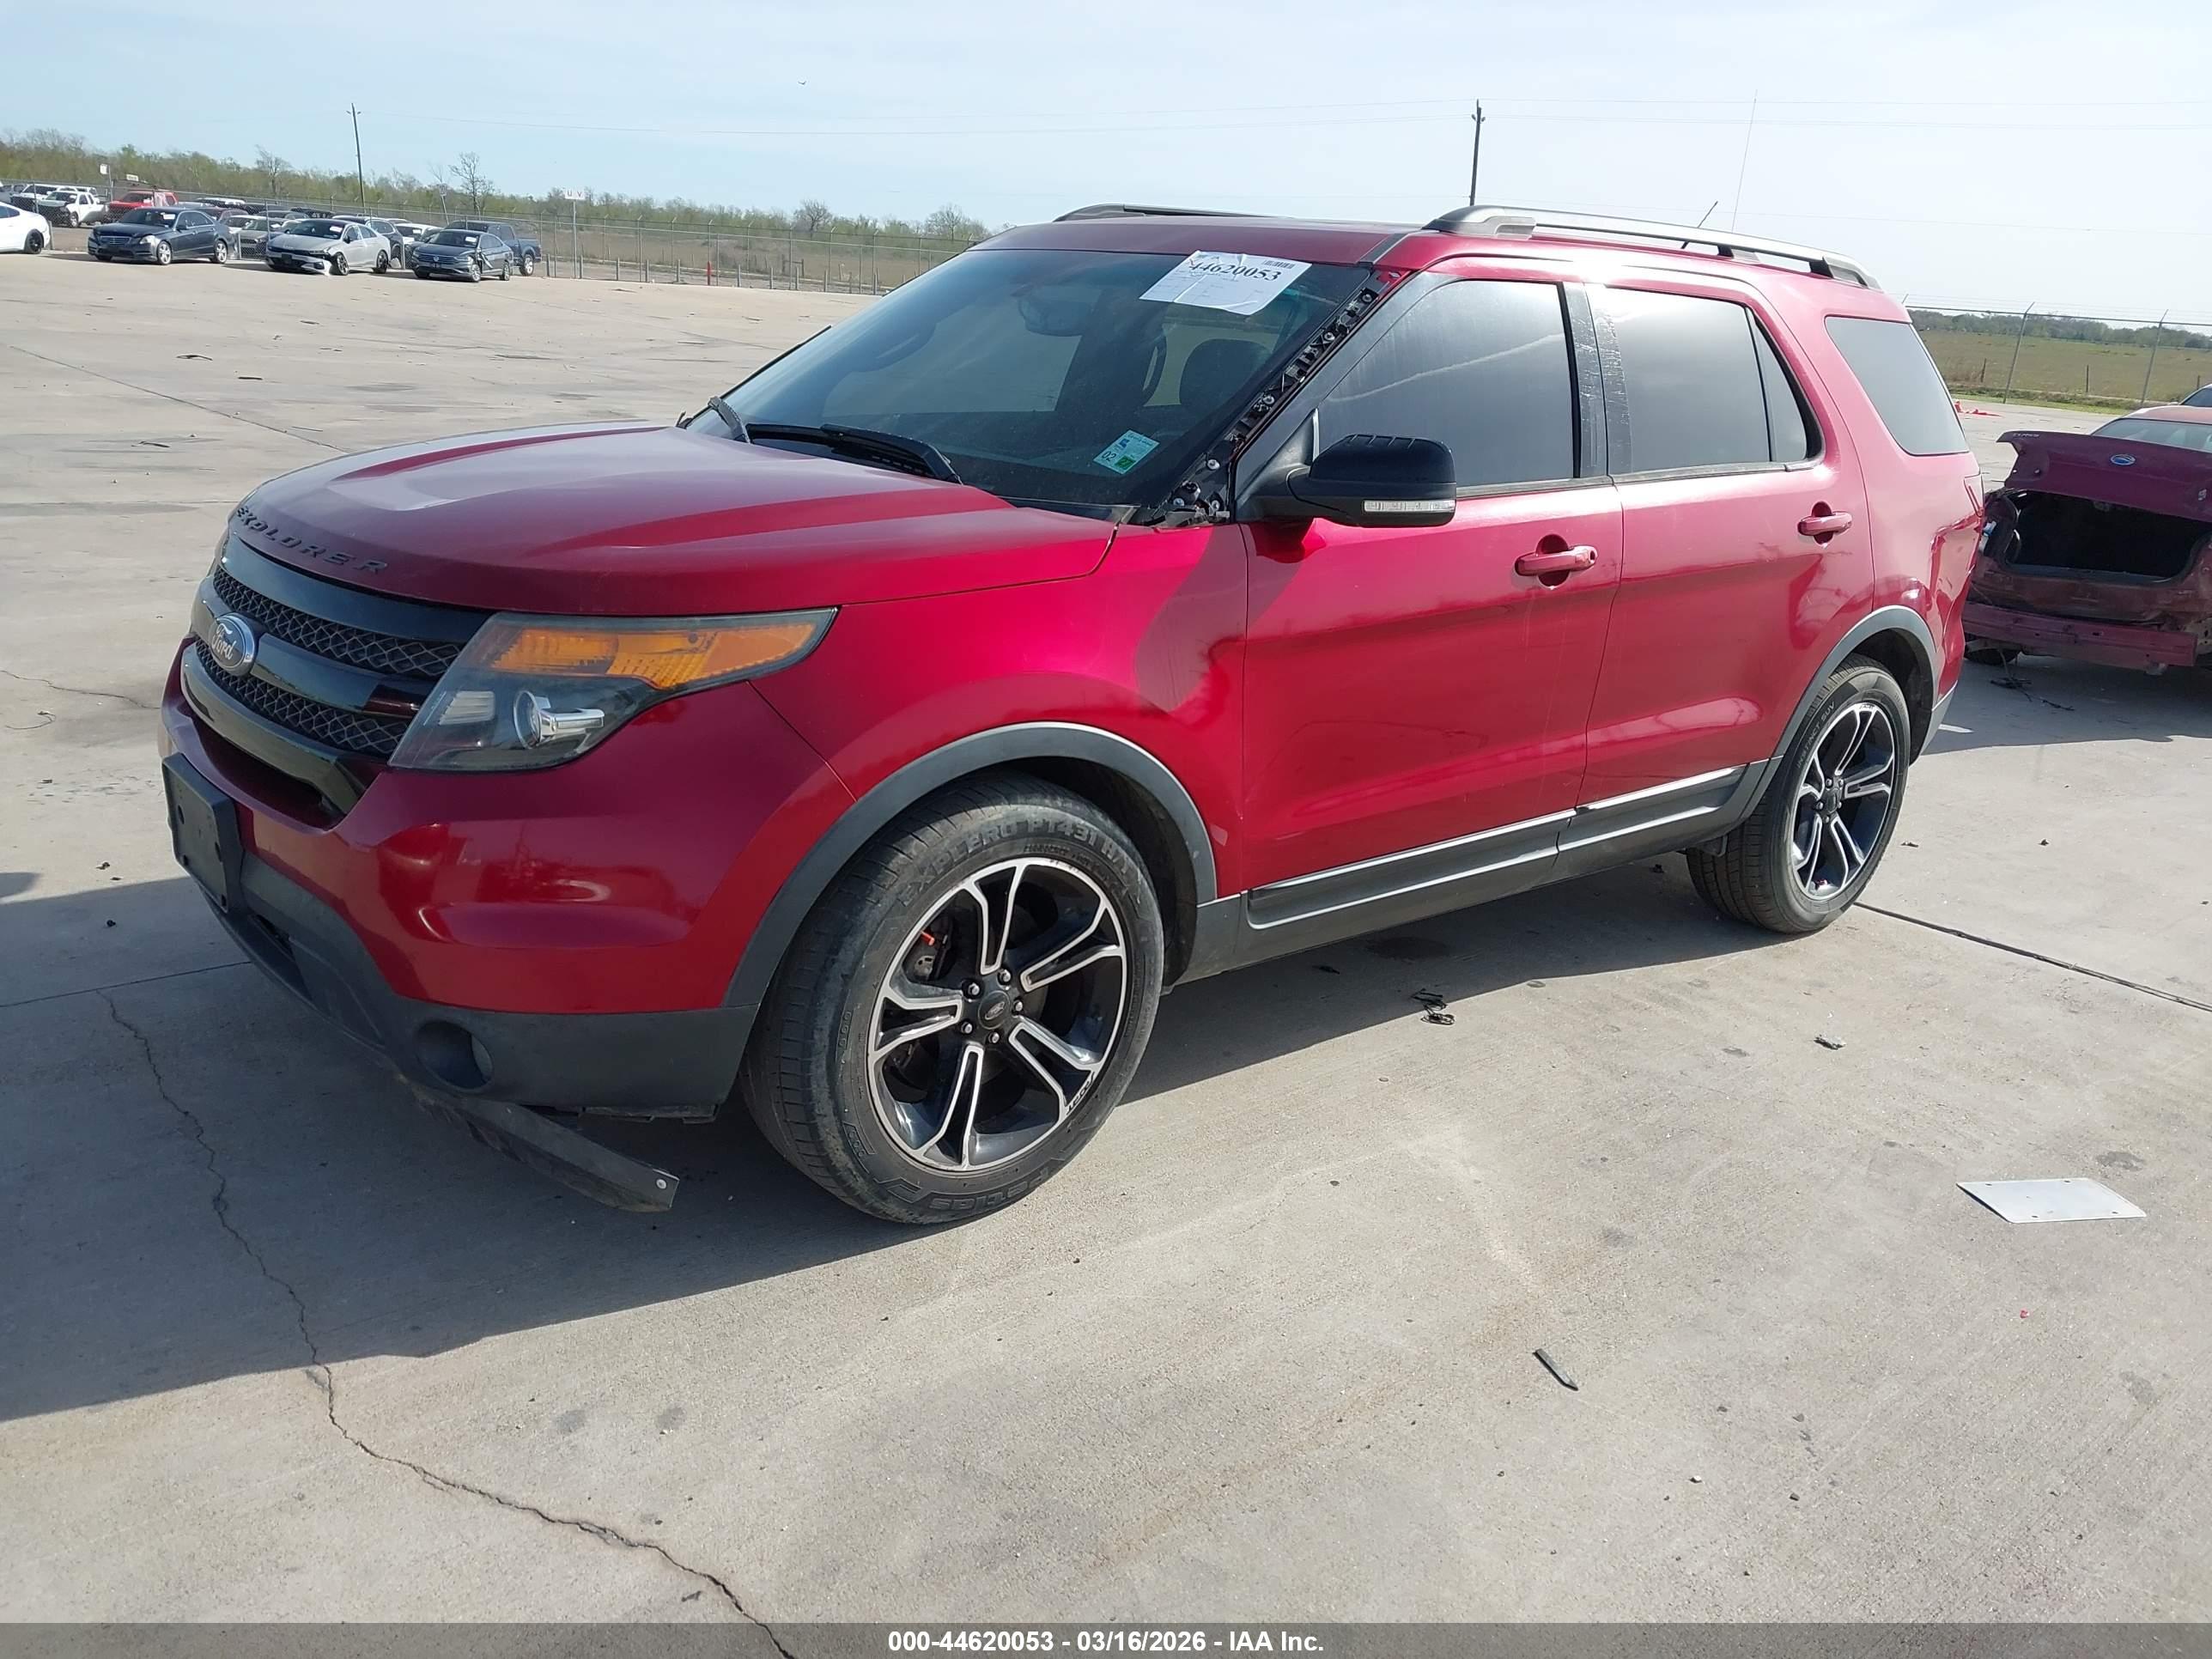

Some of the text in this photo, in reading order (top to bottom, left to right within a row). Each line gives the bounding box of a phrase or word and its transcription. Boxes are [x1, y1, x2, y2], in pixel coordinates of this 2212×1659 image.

[1188, 261, 1282, 282] 44620053
[236, 506, 389, 574] EXPLORER
[212, 623, 238, 660] Ford
[1821, 701, 1835, 722] SUV
[1027, 817, 1098, 847] PT431
